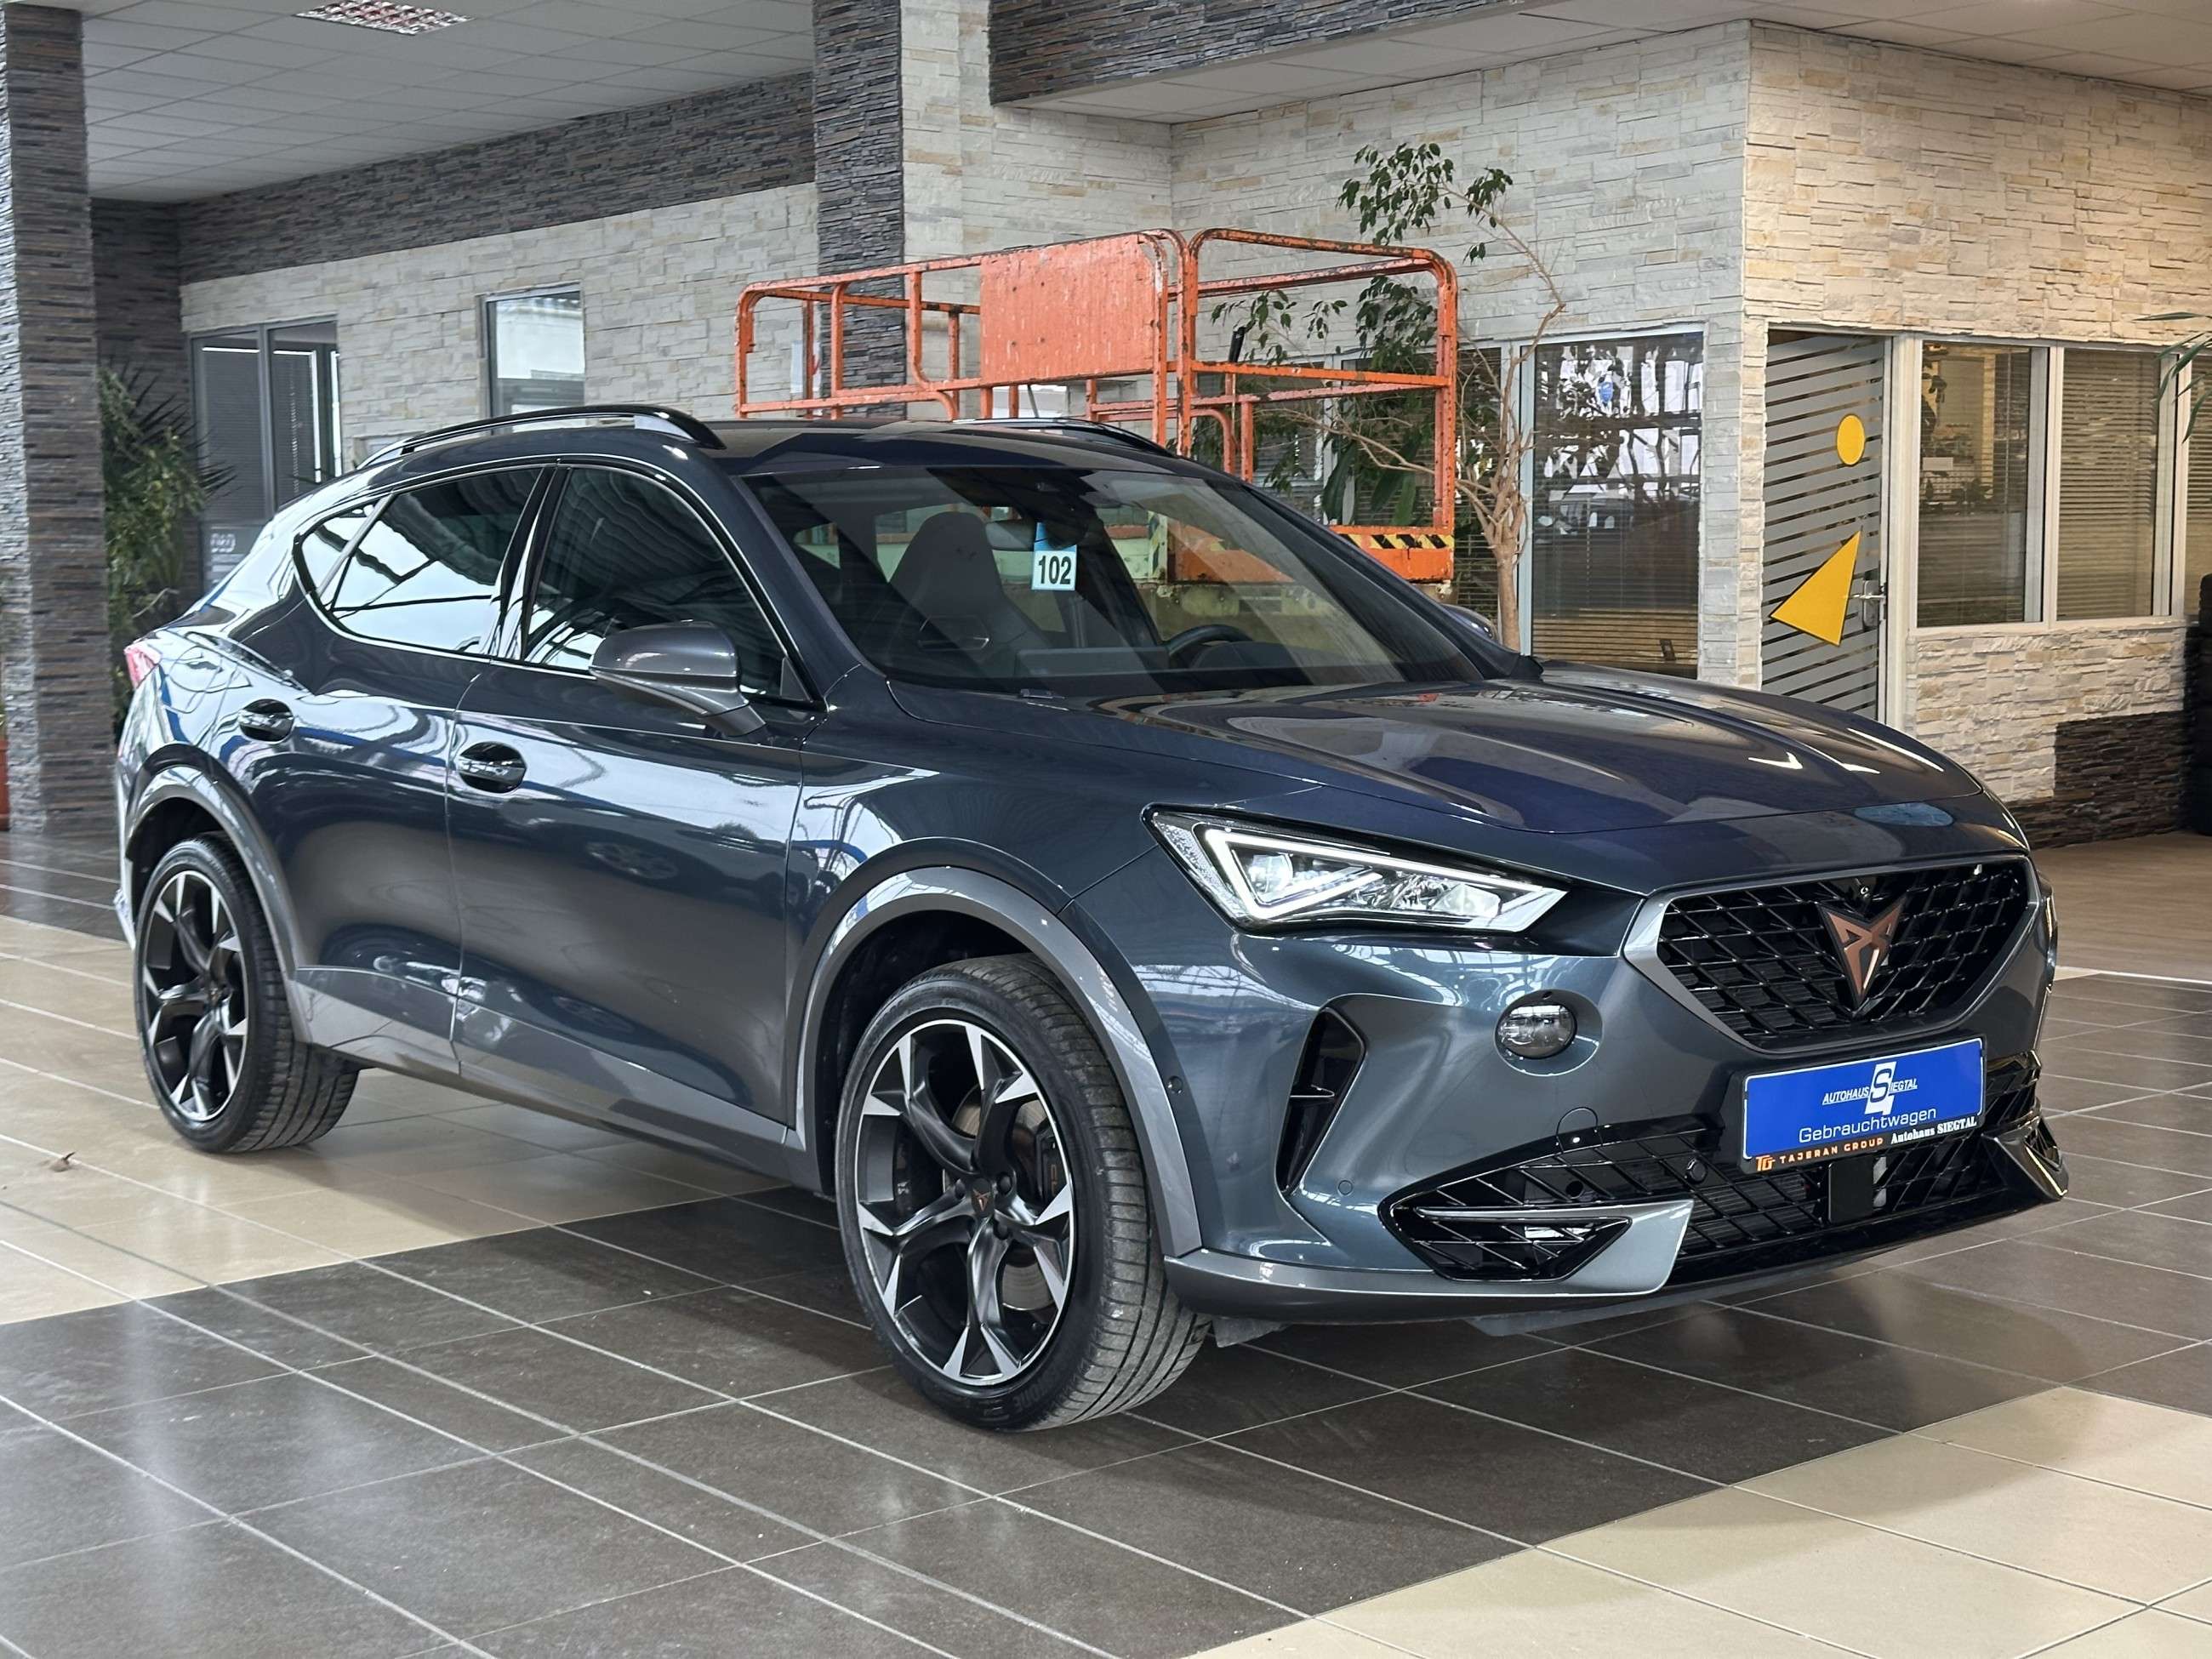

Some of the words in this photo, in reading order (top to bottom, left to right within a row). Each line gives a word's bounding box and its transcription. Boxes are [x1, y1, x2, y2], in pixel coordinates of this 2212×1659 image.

[1038, 555, 1072, 584] 102
[1822, 1086, 1870, 1105] AUTOHAUS
[1799, 1108, 1936, 1143] Gebrauchtwagen
[1890, 1127, 1936, 1145] Autohaus
[1936, 1116, 1977, 1134] SIEGTAL
[1844, 1137, 1884, 1152] GROUP
